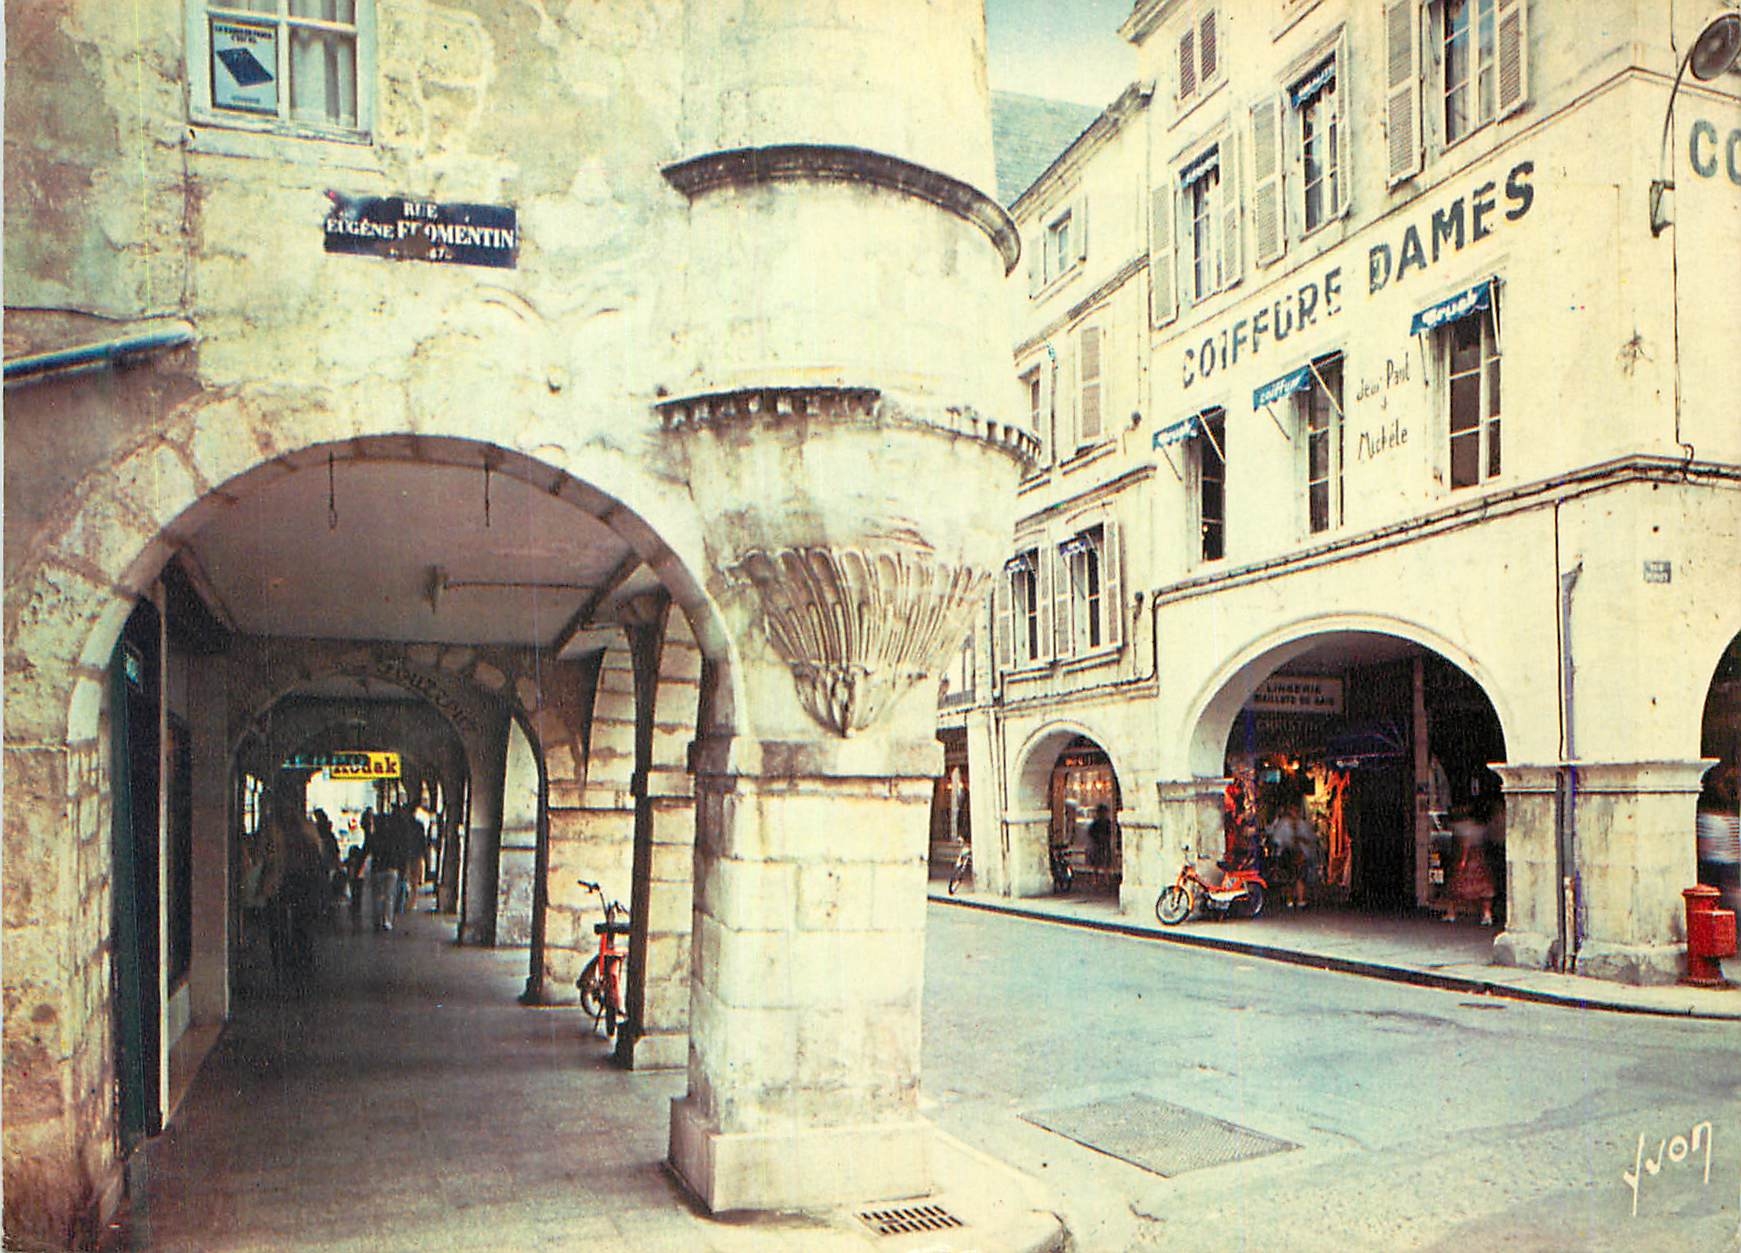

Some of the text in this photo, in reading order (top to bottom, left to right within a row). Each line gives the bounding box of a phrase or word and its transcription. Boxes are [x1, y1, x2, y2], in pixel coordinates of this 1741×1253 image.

[403, 201, 439, 219] RUE
[1183, 160, 1535, 389] COIFFURE DAMES
[333, 756, 398, 774] odak
